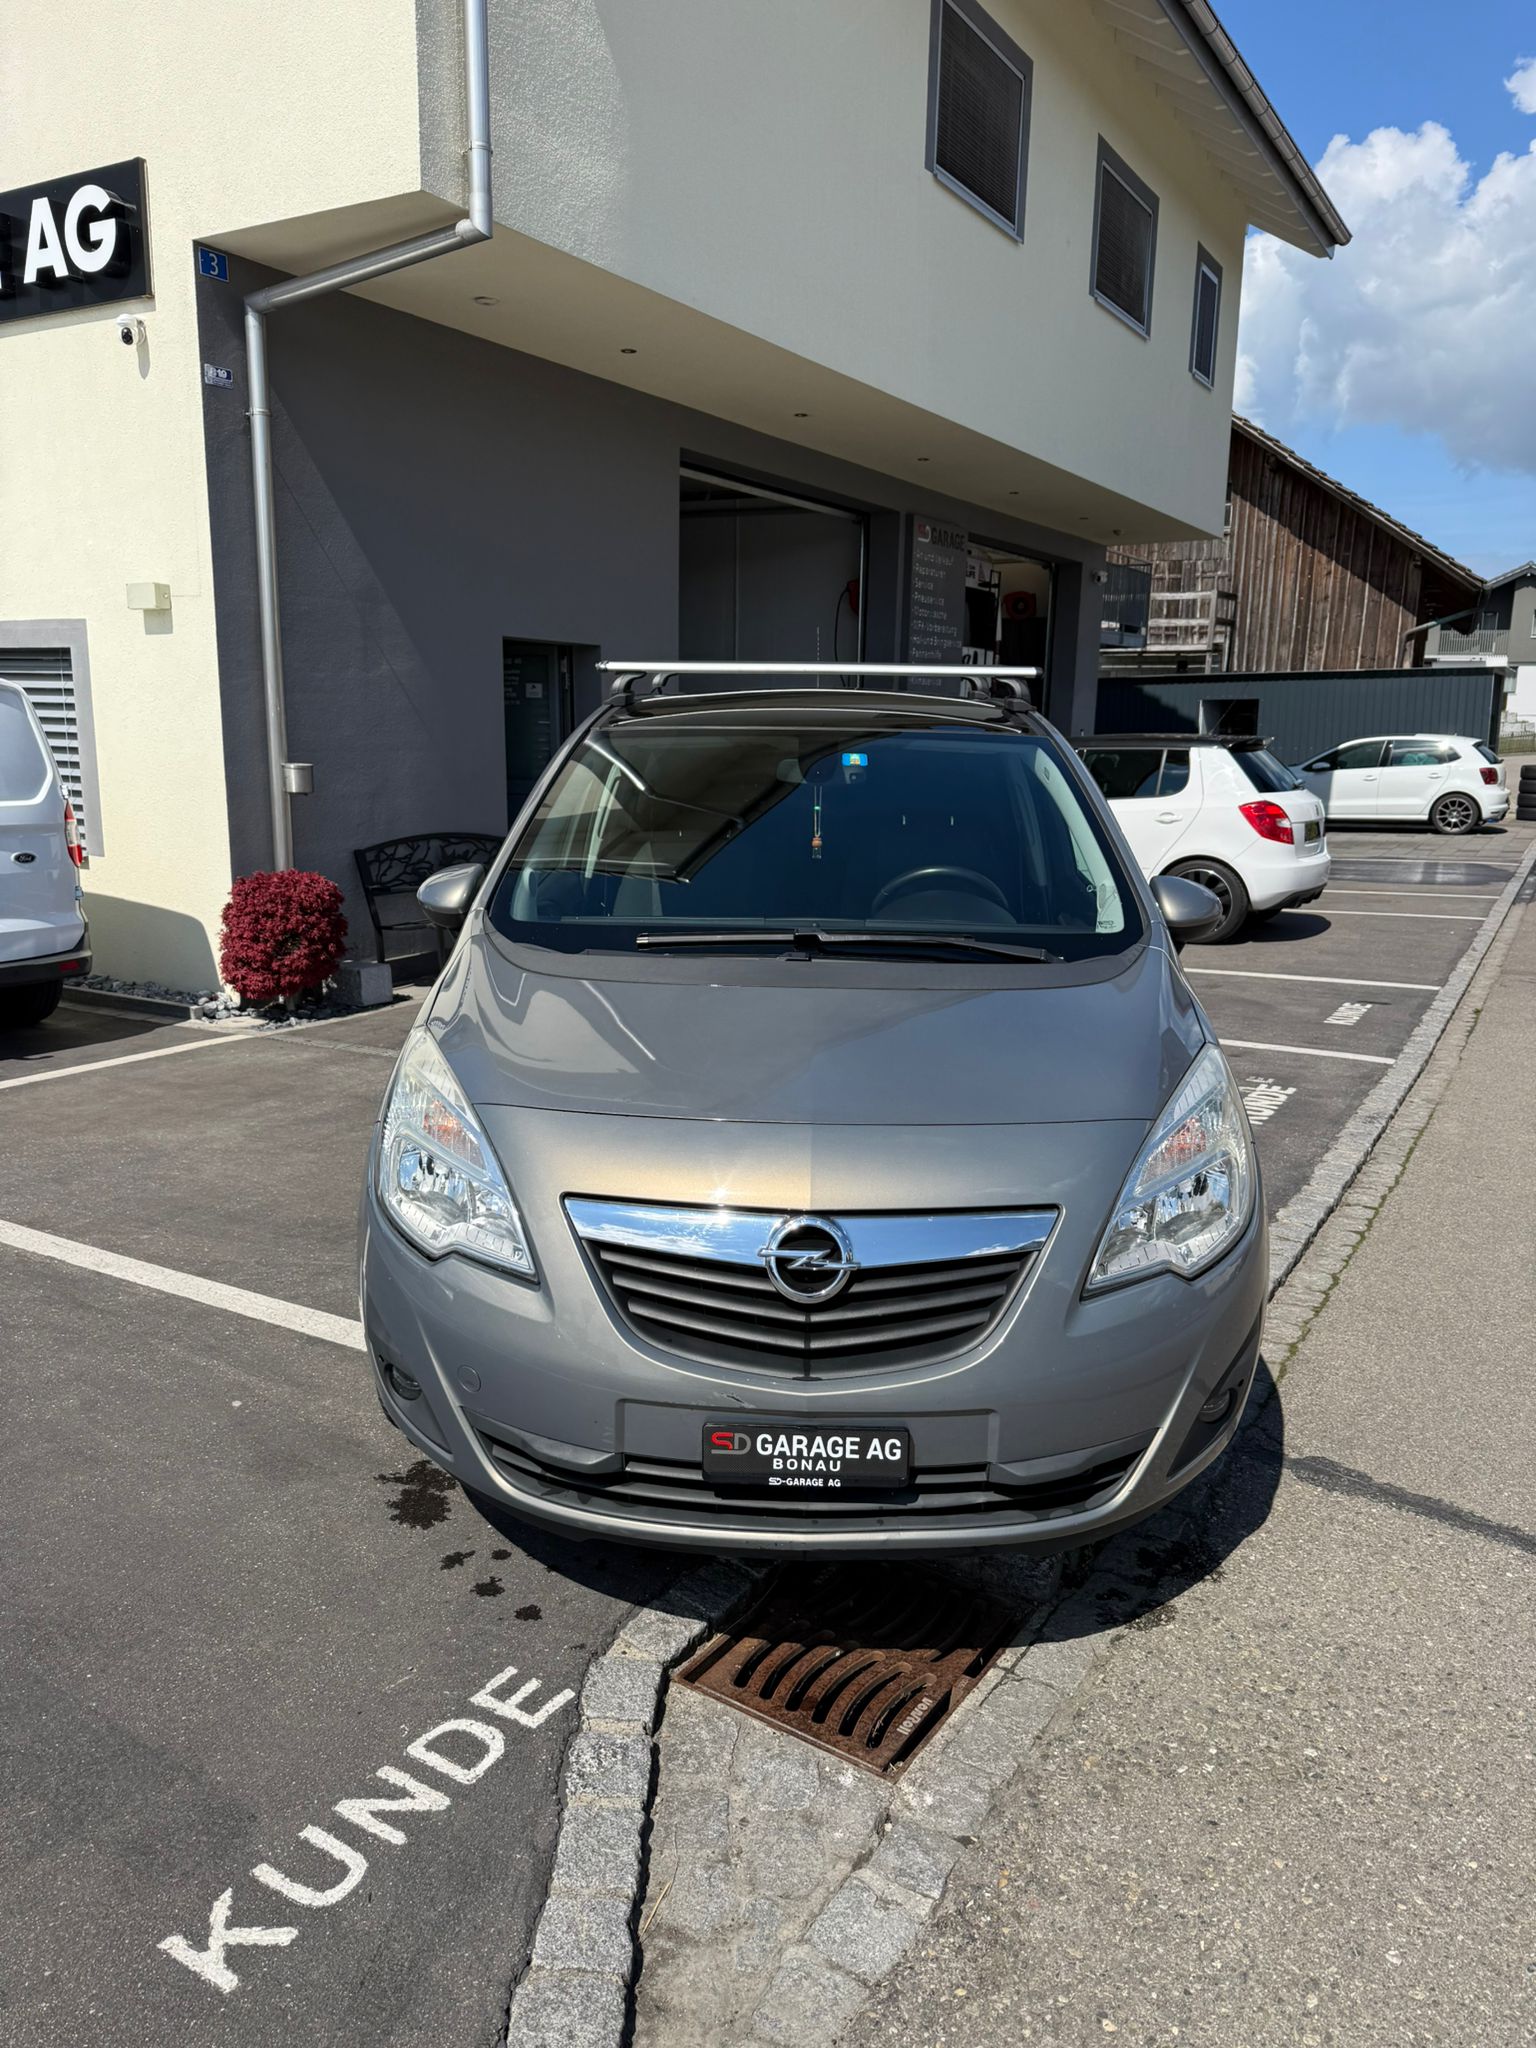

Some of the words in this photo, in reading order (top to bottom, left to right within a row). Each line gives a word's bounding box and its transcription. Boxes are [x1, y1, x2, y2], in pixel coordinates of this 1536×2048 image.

[24, 184, 117, 284] AG
[209, 253, 219, 275] 3
[931, 528, 966, 550] GARAGE
[1323, 1002, 1373, 1026] KUNDE
[756, 1433, 861, 1459] GARAGE
[866, 1438, 902, 1461] AG
[772, 1458, 841, 1472] BONAU
[768, 1477, 824, 1487] SD-GARAGE
[828, 1478, 841, 1488] AG
[157, 1665, 576, 1993] KUNDE
